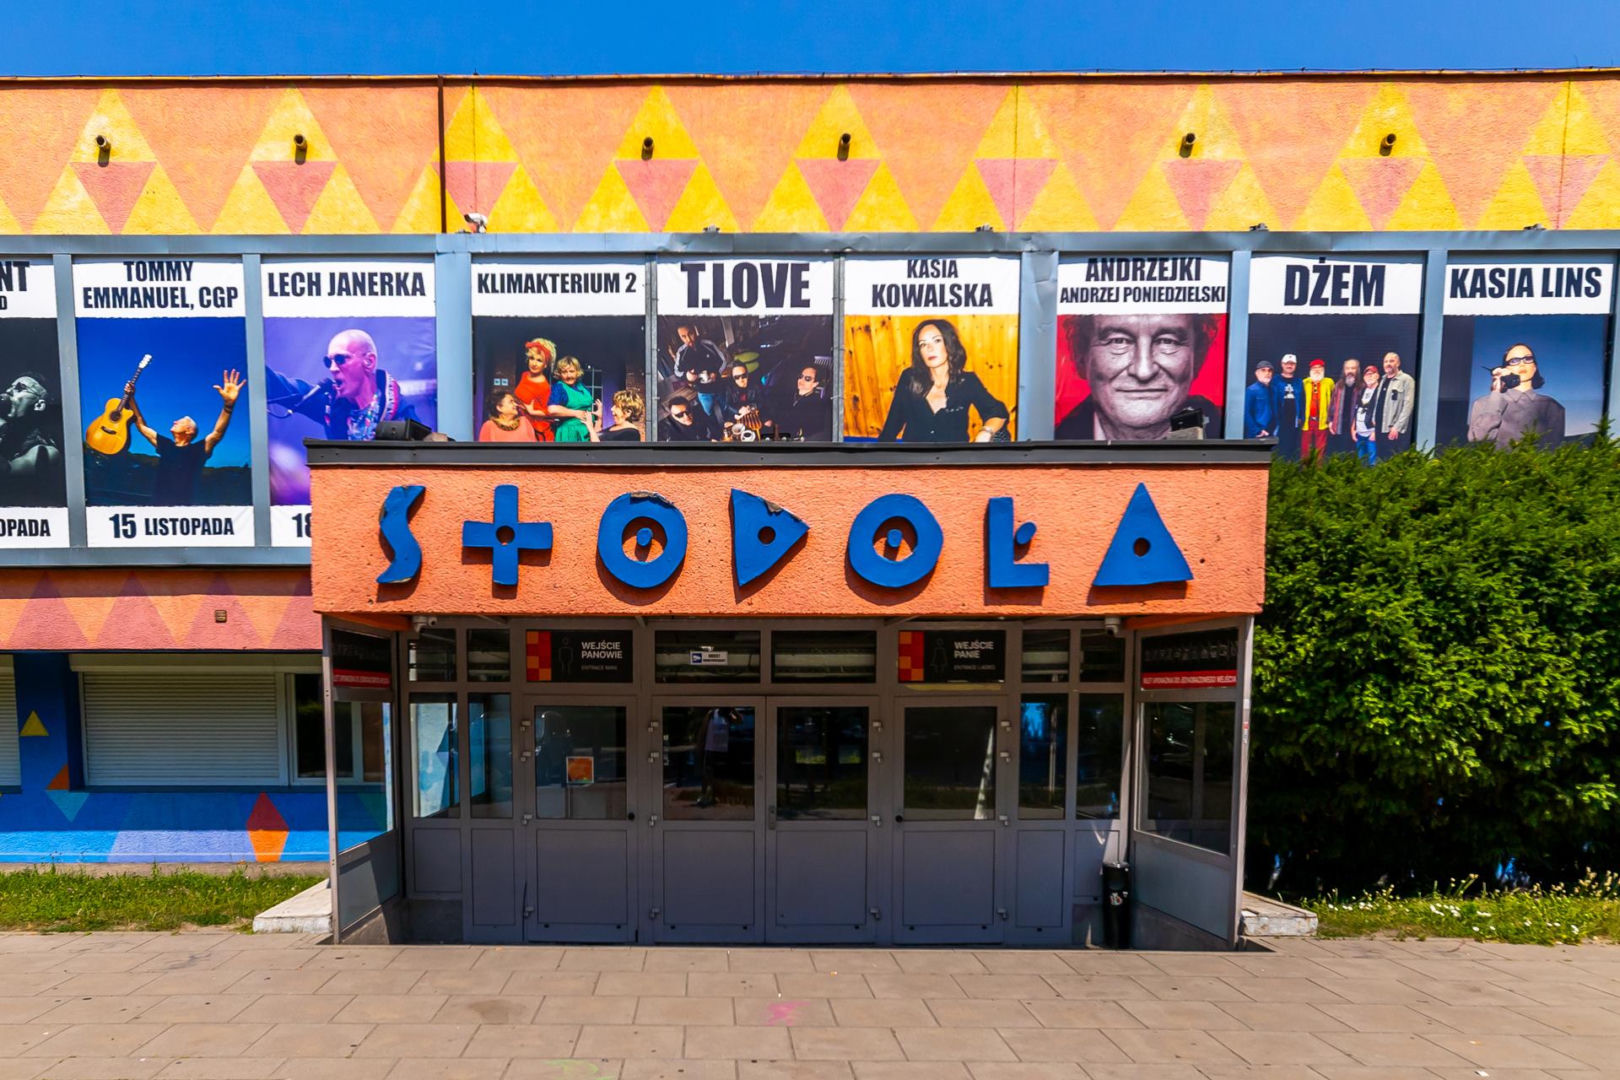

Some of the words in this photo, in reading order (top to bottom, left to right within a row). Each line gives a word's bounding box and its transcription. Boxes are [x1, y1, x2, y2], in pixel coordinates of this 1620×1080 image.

[123, 261, 193, 281] TOMMY
[907, 259, 958, 278] KASIA
[1085, 257, 1202, 282] ANDRZEJKI
[268, 272, 321, 297] LECH
[328, 272, 426, 297] JANERKA
[477, 272, 620, 294] KLIMAKTERIUM
[625, 272, 637, 293] 2
[680, 262, 810, 308] T.LOVE
[1284, 257, 1386, 306] DŻEM
[1449, 267, 1534, 298] KASIA
[1541, 267, 1602, 298] LINS
[83, 287, 194, 310] EMMANUEL,
[198, 286, 238, 308] CGP
[871, 283, 993, 307] KOWALSKA
[1060, 287, 1120, 303] ANDRZEJ
[1123, 286, 1226, 303] PONIEDZIELSKI
[109, 513, 137, 539] 15
[144, 517, 235, 536] LISTOPADA
[376, 482, 1194, 589] STODOŁA
[581, 640, 621, 650] WEJŚCIE
[581, 650, 623, 659] PANOWIE
[953, 639, 995, 650] WEJŚCIE
[953, 650, 981, 659] PANIE
